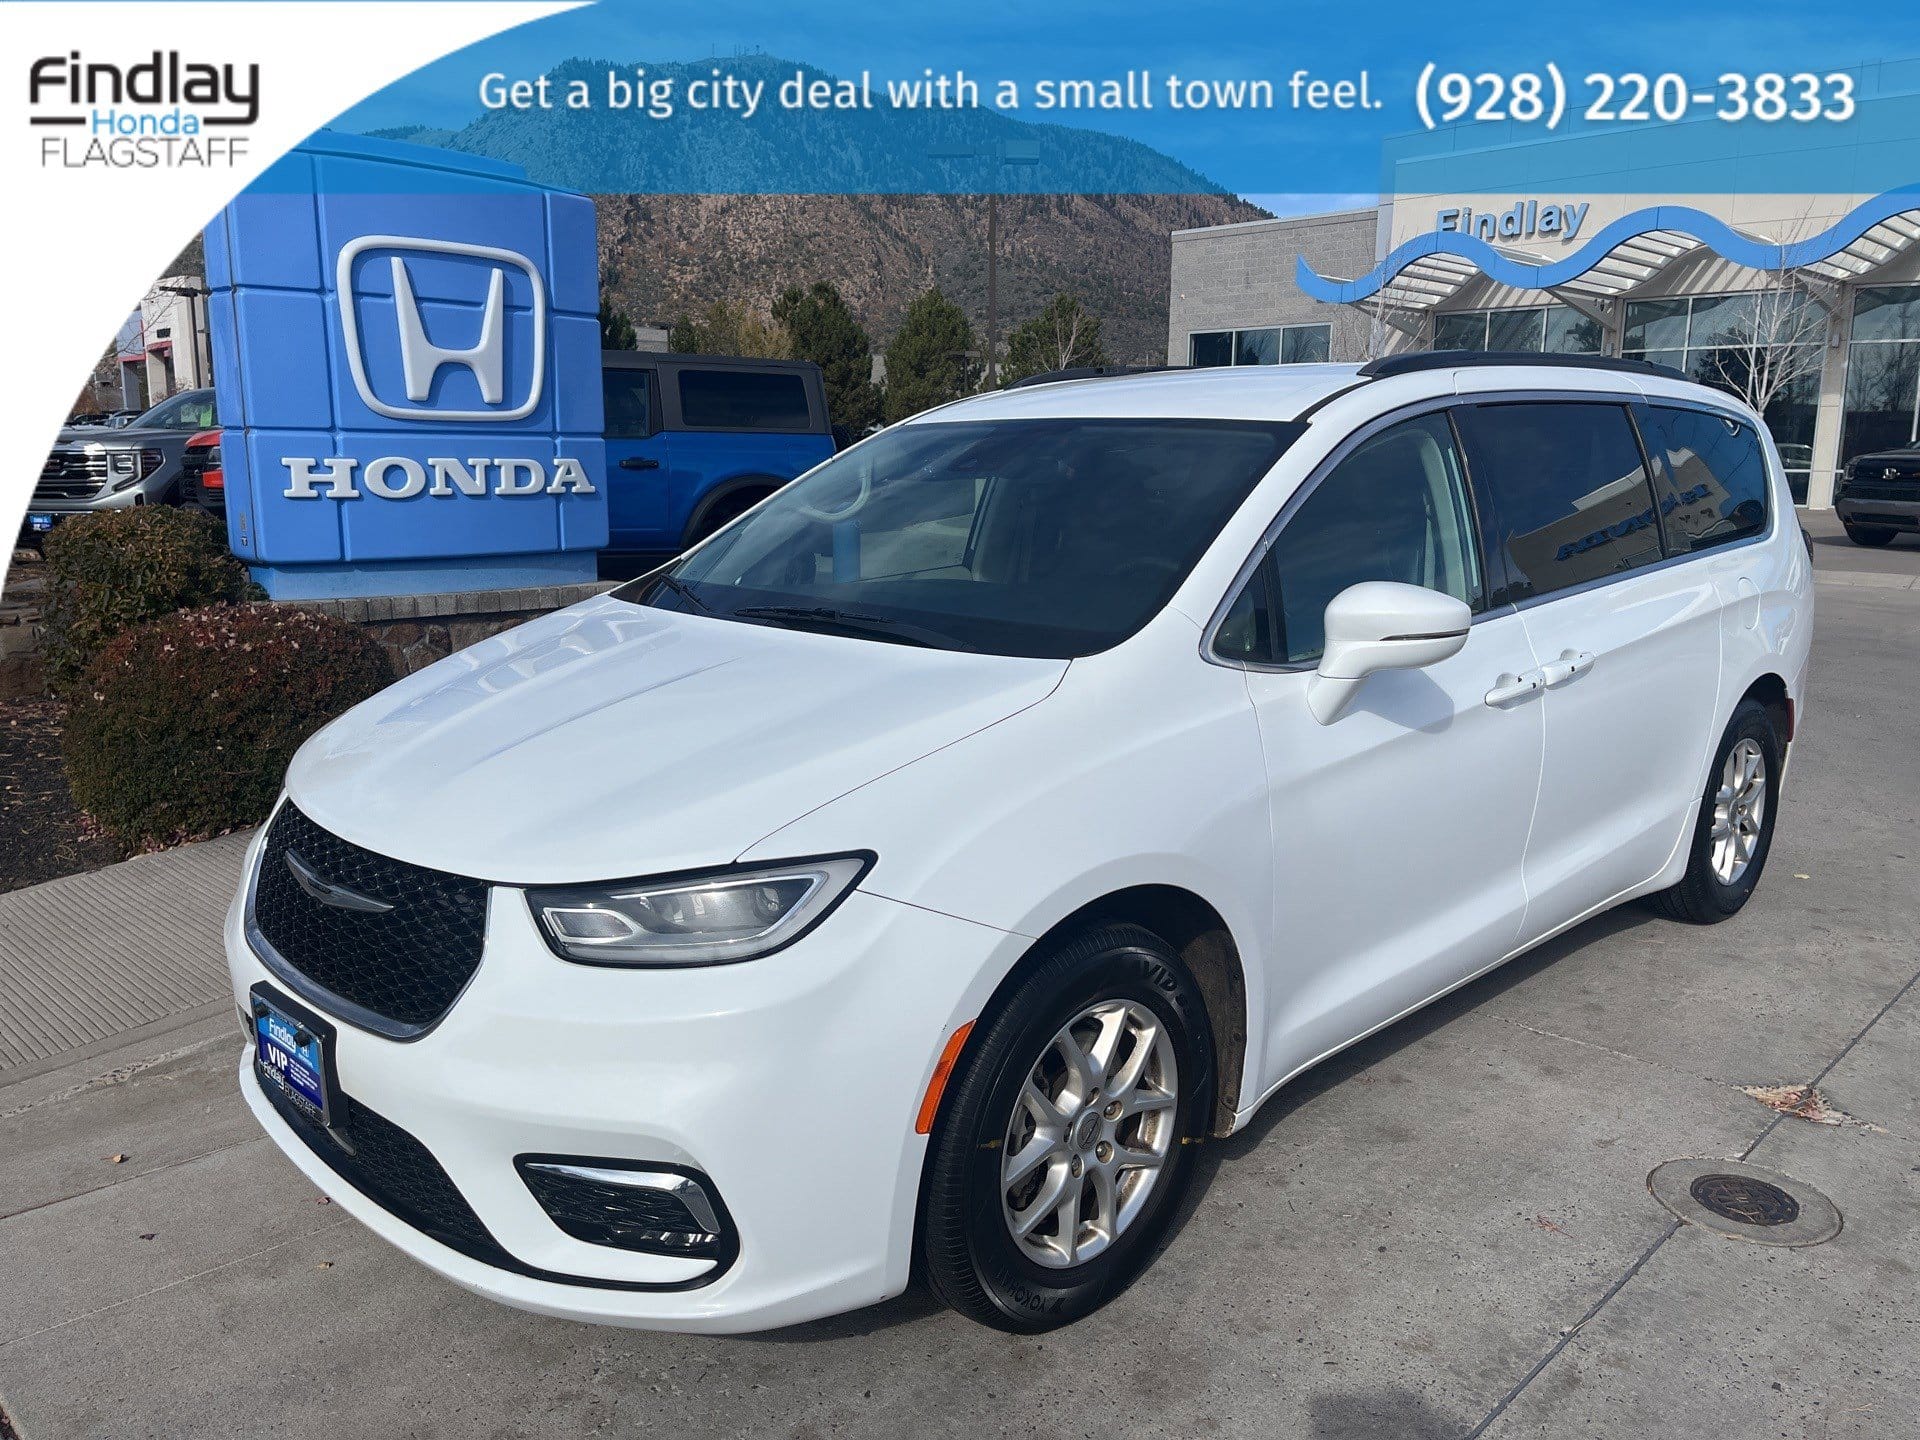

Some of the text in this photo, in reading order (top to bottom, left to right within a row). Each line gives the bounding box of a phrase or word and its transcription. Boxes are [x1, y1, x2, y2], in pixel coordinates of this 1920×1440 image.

[281, 456, 596, 499] HONDA
[269, 1018, 296, 1053] Findlay
[267, 1043, 288, 1070] VIP
